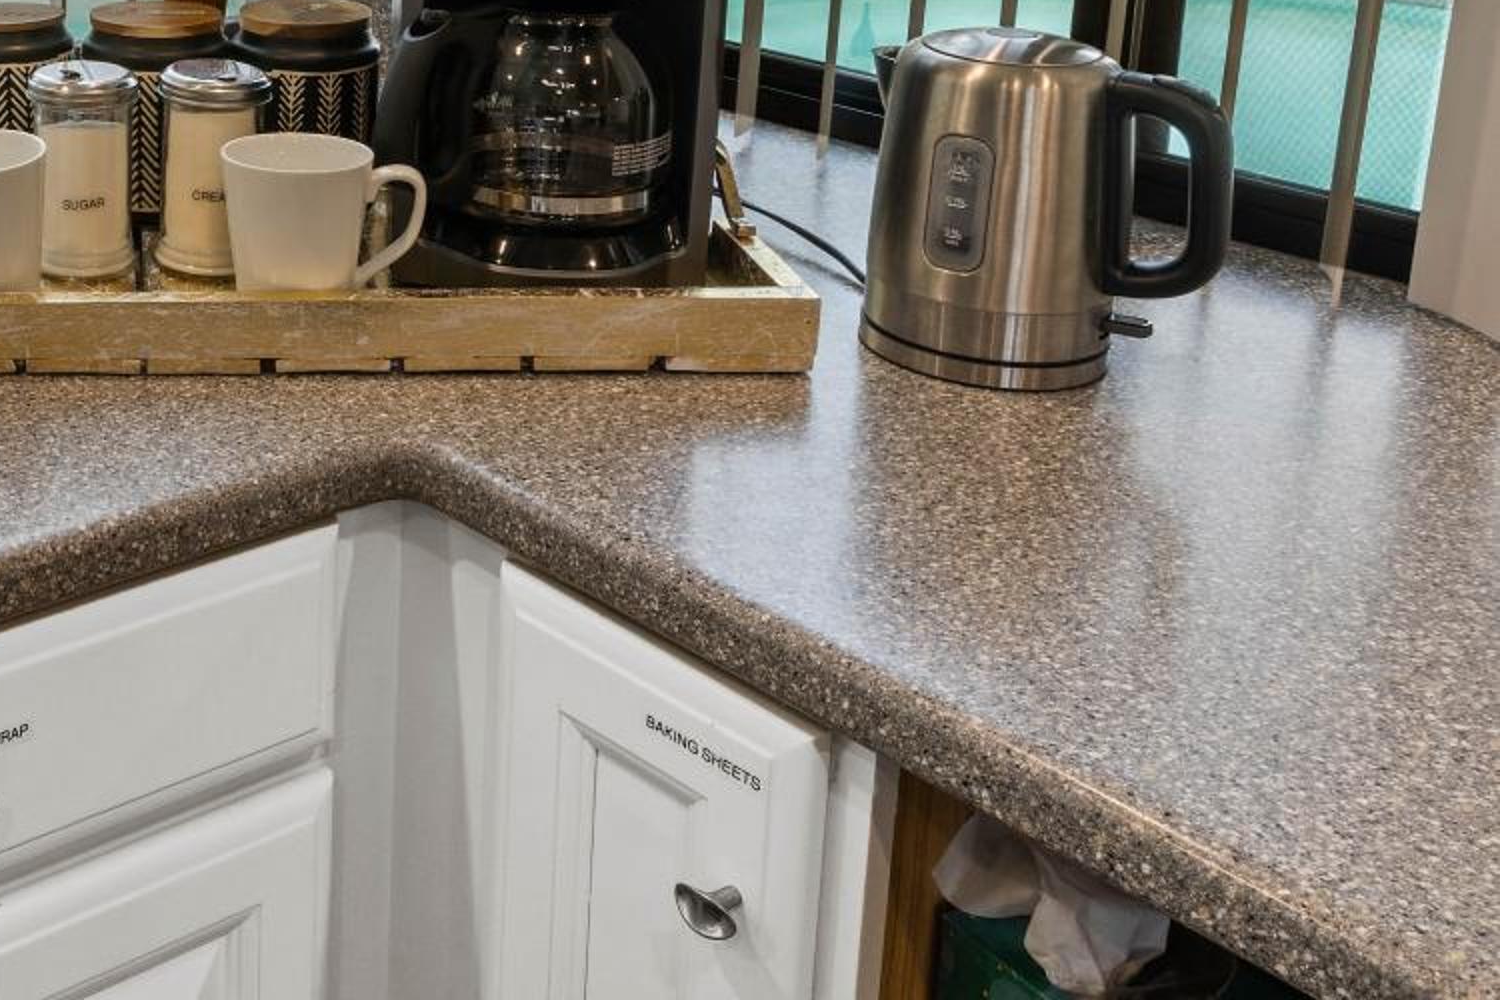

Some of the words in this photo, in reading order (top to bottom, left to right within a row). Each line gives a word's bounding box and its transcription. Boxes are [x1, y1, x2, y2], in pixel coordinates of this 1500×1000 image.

[191, 187, 226, 203] CREA
[62, 197, 105, 212] SUGAR
[645, 715, 699, 755] BAKING
[701, 748, 762, 792] SHEETS
